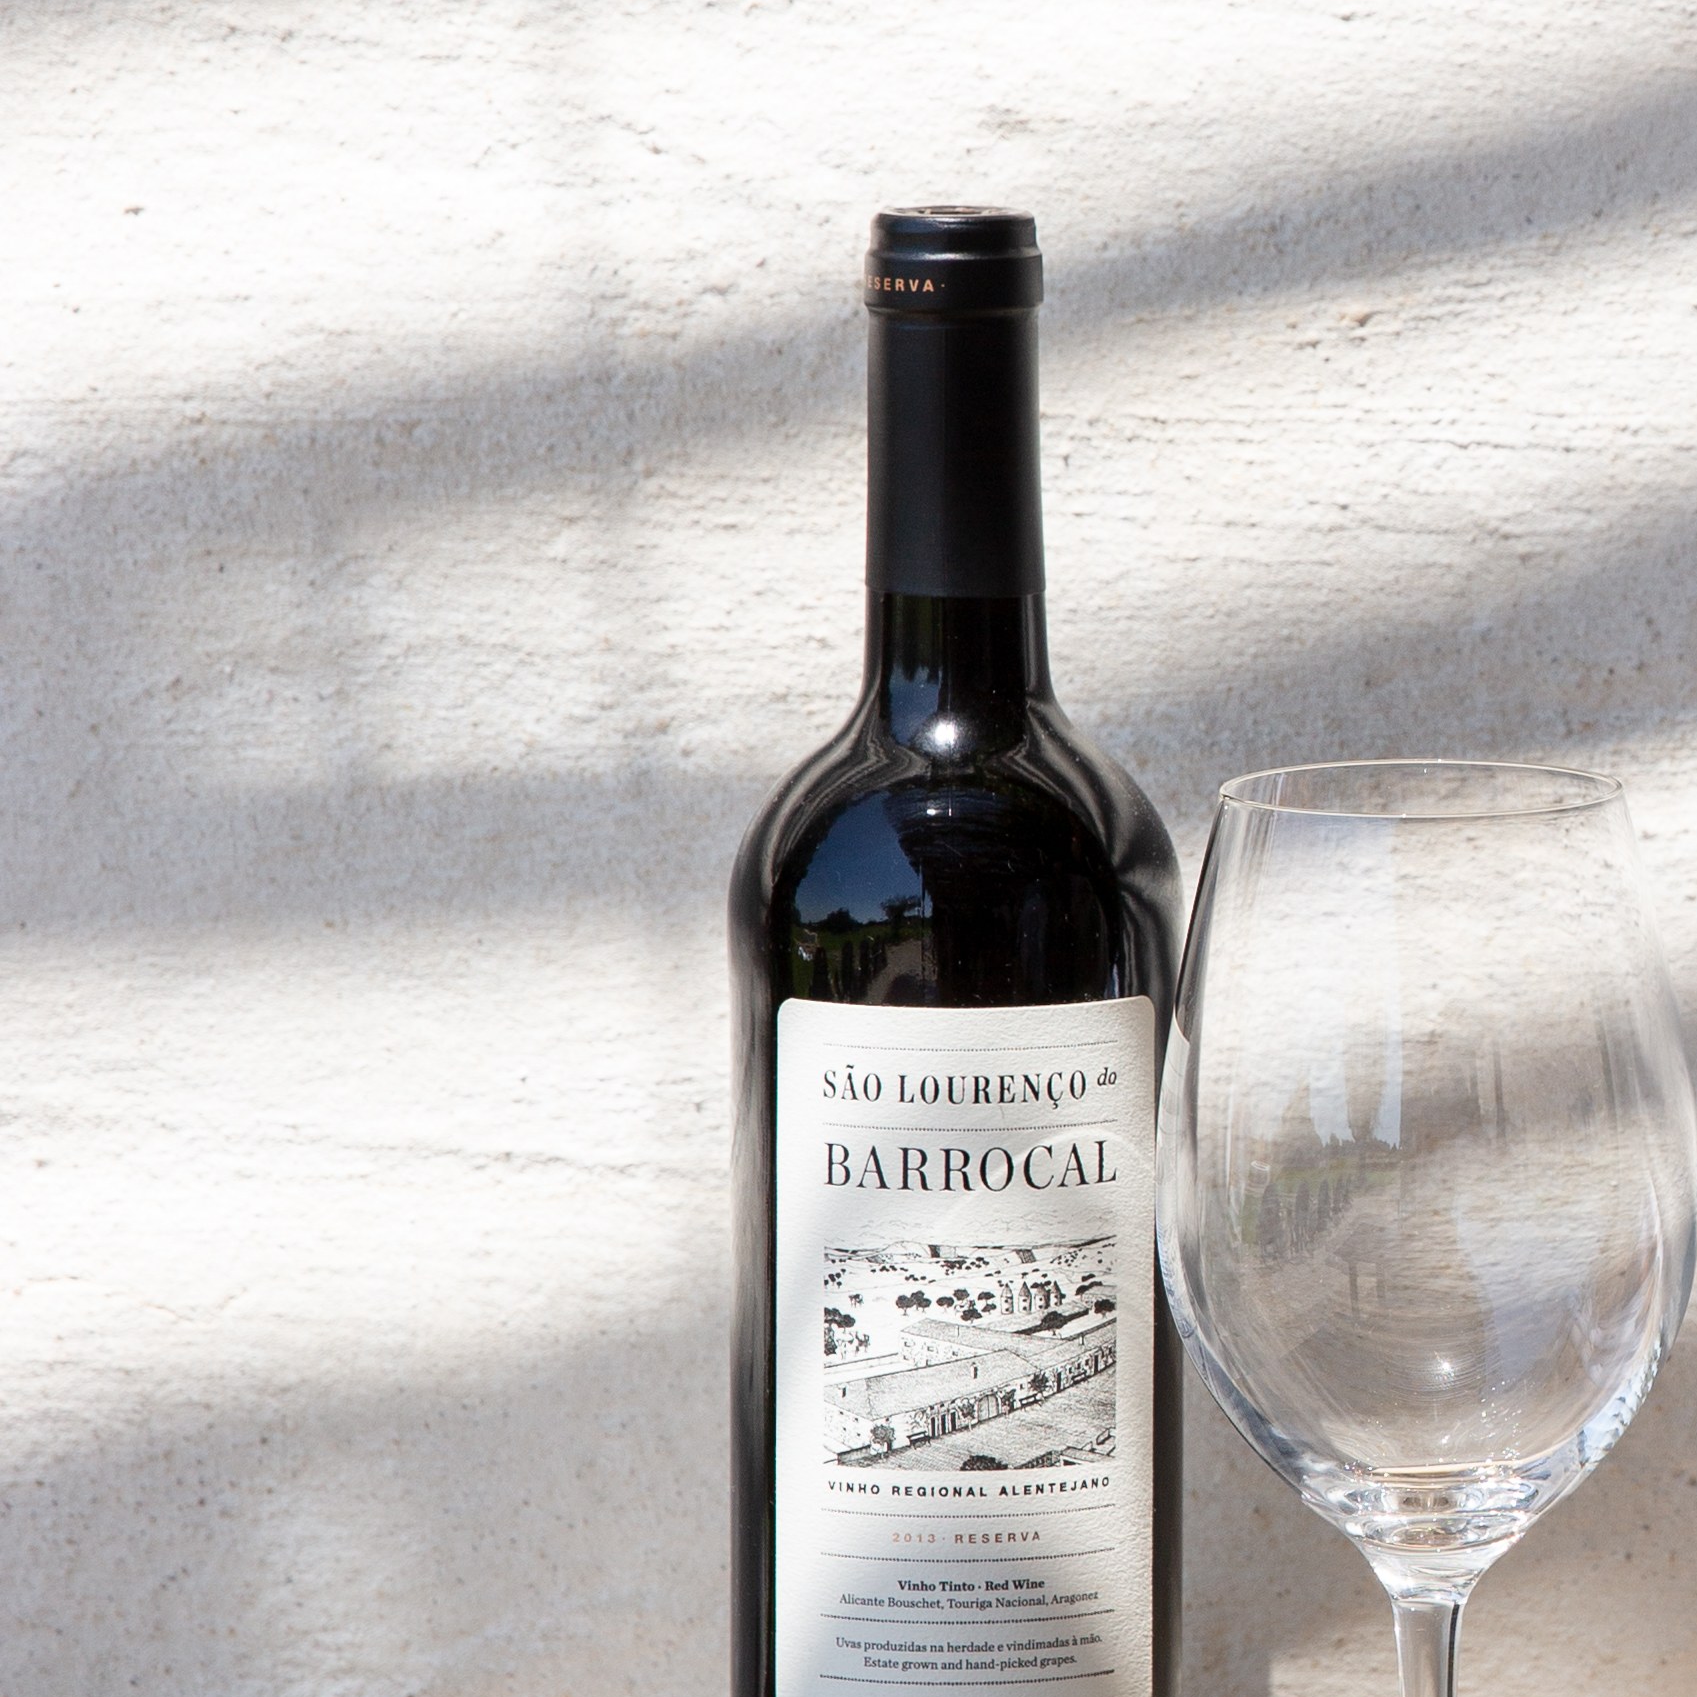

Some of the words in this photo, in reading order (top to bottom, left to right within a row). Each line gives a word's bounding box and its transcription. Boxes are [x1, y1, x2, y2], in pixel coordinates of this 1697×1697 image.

[866, 275, 934, 292] ESERVA
[823, 1065, 882, 1103] SÃO
[898, 1069, 1087, 1109] LOURENÇO
[1097, 1067, 1118, 1087] do
[824, 1140, 1118, 1192] BARROCAL
[828, 1480, 880, 1495] VINHO
[892, 1485, 987, 1498] REGIONAL
[999, 1476, 1110, 1497] ALENTEJANO
[892, 1532, 936, 1544] 2013
[954, 1531, 1041, 1545] RESERVA
[897, 1580, 936, 1592] Vinho
[939, 1580, 975, 1592] Tinto
[984, 1580, 1009, 1592] Red
[1012, 1578, 1045, 1591] Wine
[839, 1593, 885, 1608] Alicante
[887, 1596, 945, 1610] Bouschet,
[946, 1598, 993, 1611] Touriga
[995, 1594, 1049, 1608] Nacional,
[1051, 1591, 1098, 1605] Aragonez
[836, 1637, 862, 1649] Uvas
[864, 1639, 928, 1653] produzidas
[930, 1643, 944, 1653] na
[947, 1640, 995, 1653] herdade
[997, 1643, 1004, 1652] e
[1006, 1636, 1070, 1652] vindimadas
[864, 1656, 899, 1669] Estate
[901, 1659, 938, 1672] grown
[941, 1657, 964, 1670] and
[965, 1656, 1038, 1672] hand-picked
[1039, 1655, 1077, 1669] grapes.
